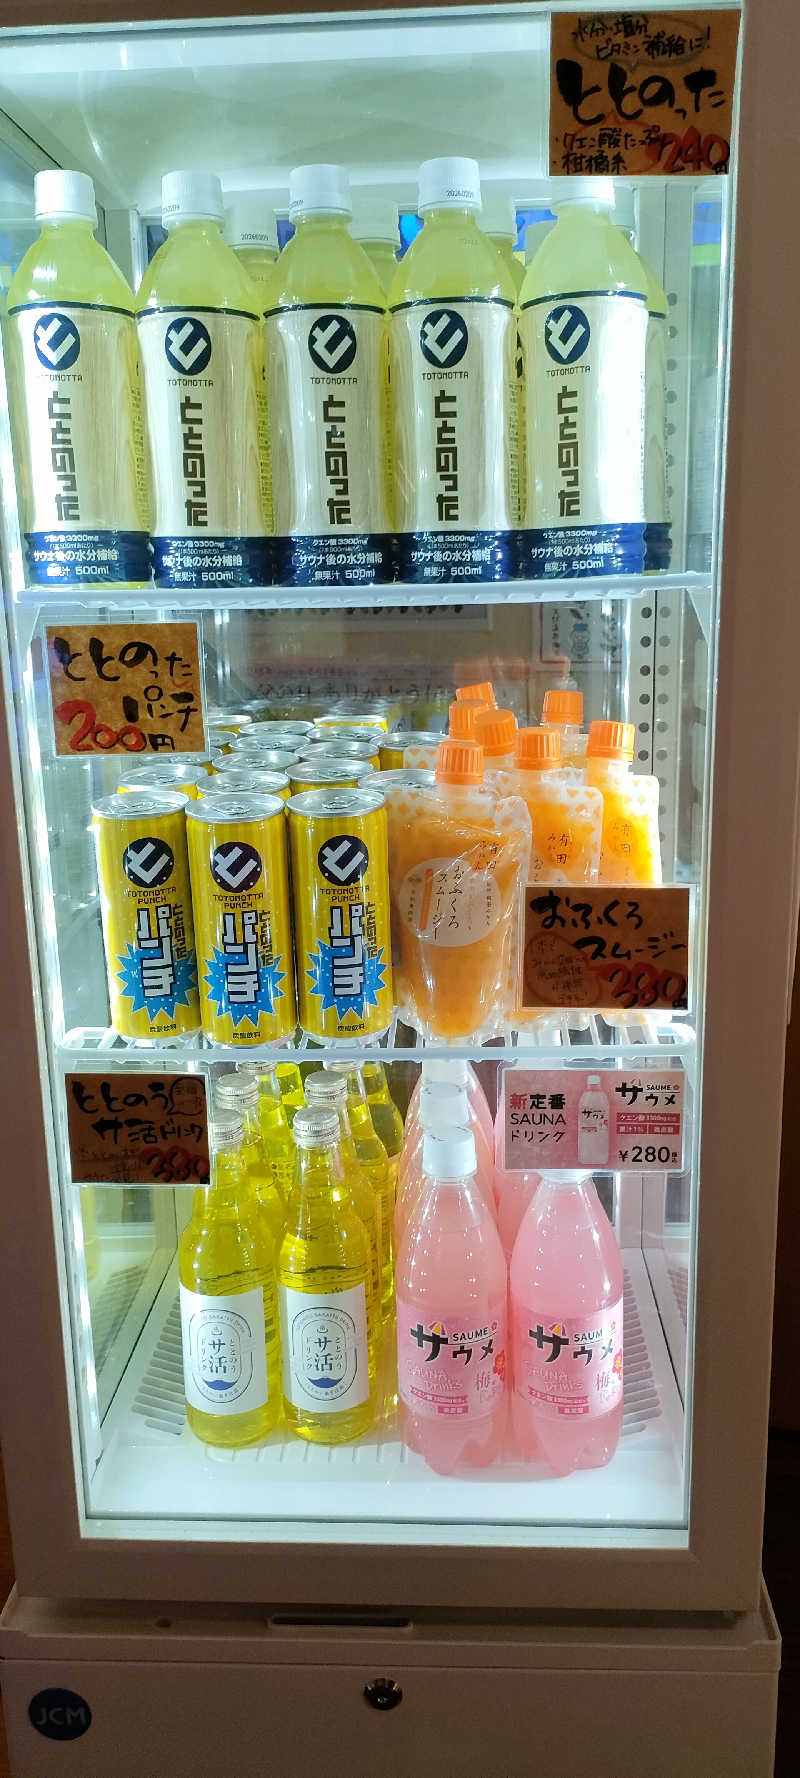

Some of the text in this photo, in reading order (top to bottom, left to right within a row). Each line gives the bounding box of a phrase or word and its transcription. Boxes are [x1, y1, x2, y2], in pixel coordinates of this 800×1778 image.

[556, 58, 726, 125] ととのった
[310, 377, 358, 385] TOTONOTTA
[422, 371, 469, 380] TOTONOTTA
[546, 365, 591, 377] TOTONOTTA
[48, 390, 81, 521] ととのった
[180, 395, 208, 527] ととのった
[322, 394, 352, 524] ととのった
[434, 390, 459, 521] ととのった
[557, 385, 581, 517] ととのった
[75, 565, 109, 576] 500ml
[201, 570, 234, 582] 500ml
[345, 568, 376, 579] 500ml
[451, 566, 482, 576] 500ml
[572, 557, 604, 570] 500ml
[54, 637, 192, 681] ととのった
[123, 686, 198, 733] パンチ
[55, 700, 175, 751] 200円
[556, 833, 569, 866] 有田
[125, 886, 176, 898] TOTONOTTA
[138, 896, 167, 905] PUNCH
[213, 893, 263, 902] TOTONOTTA
[224, 901, 253, 909] PUNCH
[320, 886, 369, 896] TOTONOTTA
[331, 894, 360, 903] PUNCH
[448, 865, 464, 930] おふくろ
[432, 872, 449, 940] スムージー
[530, 891, 644, 929] おふくろ
[137, 904, 174, 998] パンチ
[222, 910, 259, 1004] パンチ
[328, 903, 365, 997] パンチ
[573, 931, 686, 960] スムージー
[72, 1081, 169, 1113] ととのう
[510, 1093, 566, 1110] 新定番
[510, 1112, 567, 1126] SAUNA
[511, 1130, 565, 1143] ドリンク
[619, 1146, 670, 1164] ¥280
[410, 1323, 494, 1367] サウメ
[452, 1327, 488, 1341] SAUME
[529, 1324, 614, 1367] サウメ
[574, 1329, 603, 1341] SAUM
[208, 1338, 228, 1374] サ活
[313, 1336, 334, 1371] サ活
[37, 1707, 87, 1726] JCM
